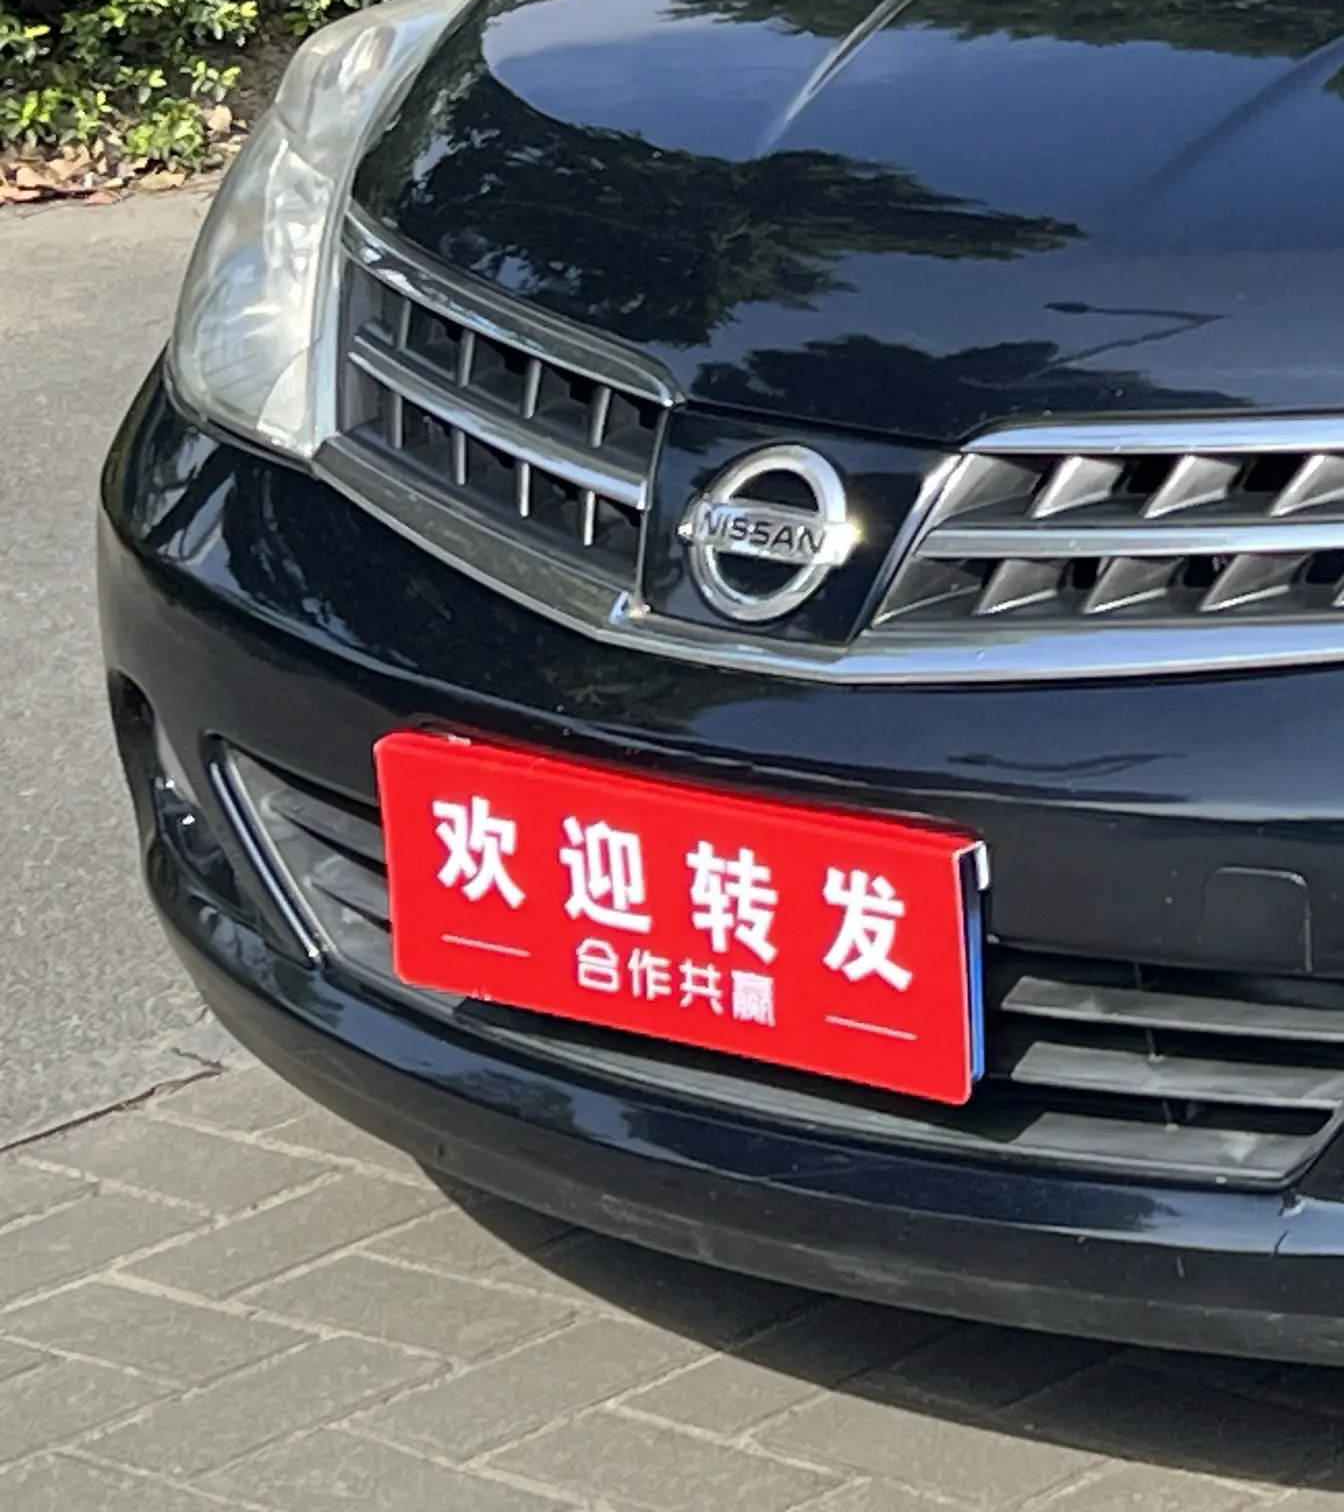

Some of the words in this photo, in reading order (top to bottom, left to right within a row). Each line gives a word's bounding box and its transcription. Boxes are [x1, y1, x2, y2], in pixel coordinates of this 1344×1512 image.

[703, 510, 826, 554] NISSAN
[431, 796, 913, 991] 欢迎转发
[576, 938, 776, 1028] 合作共赢
